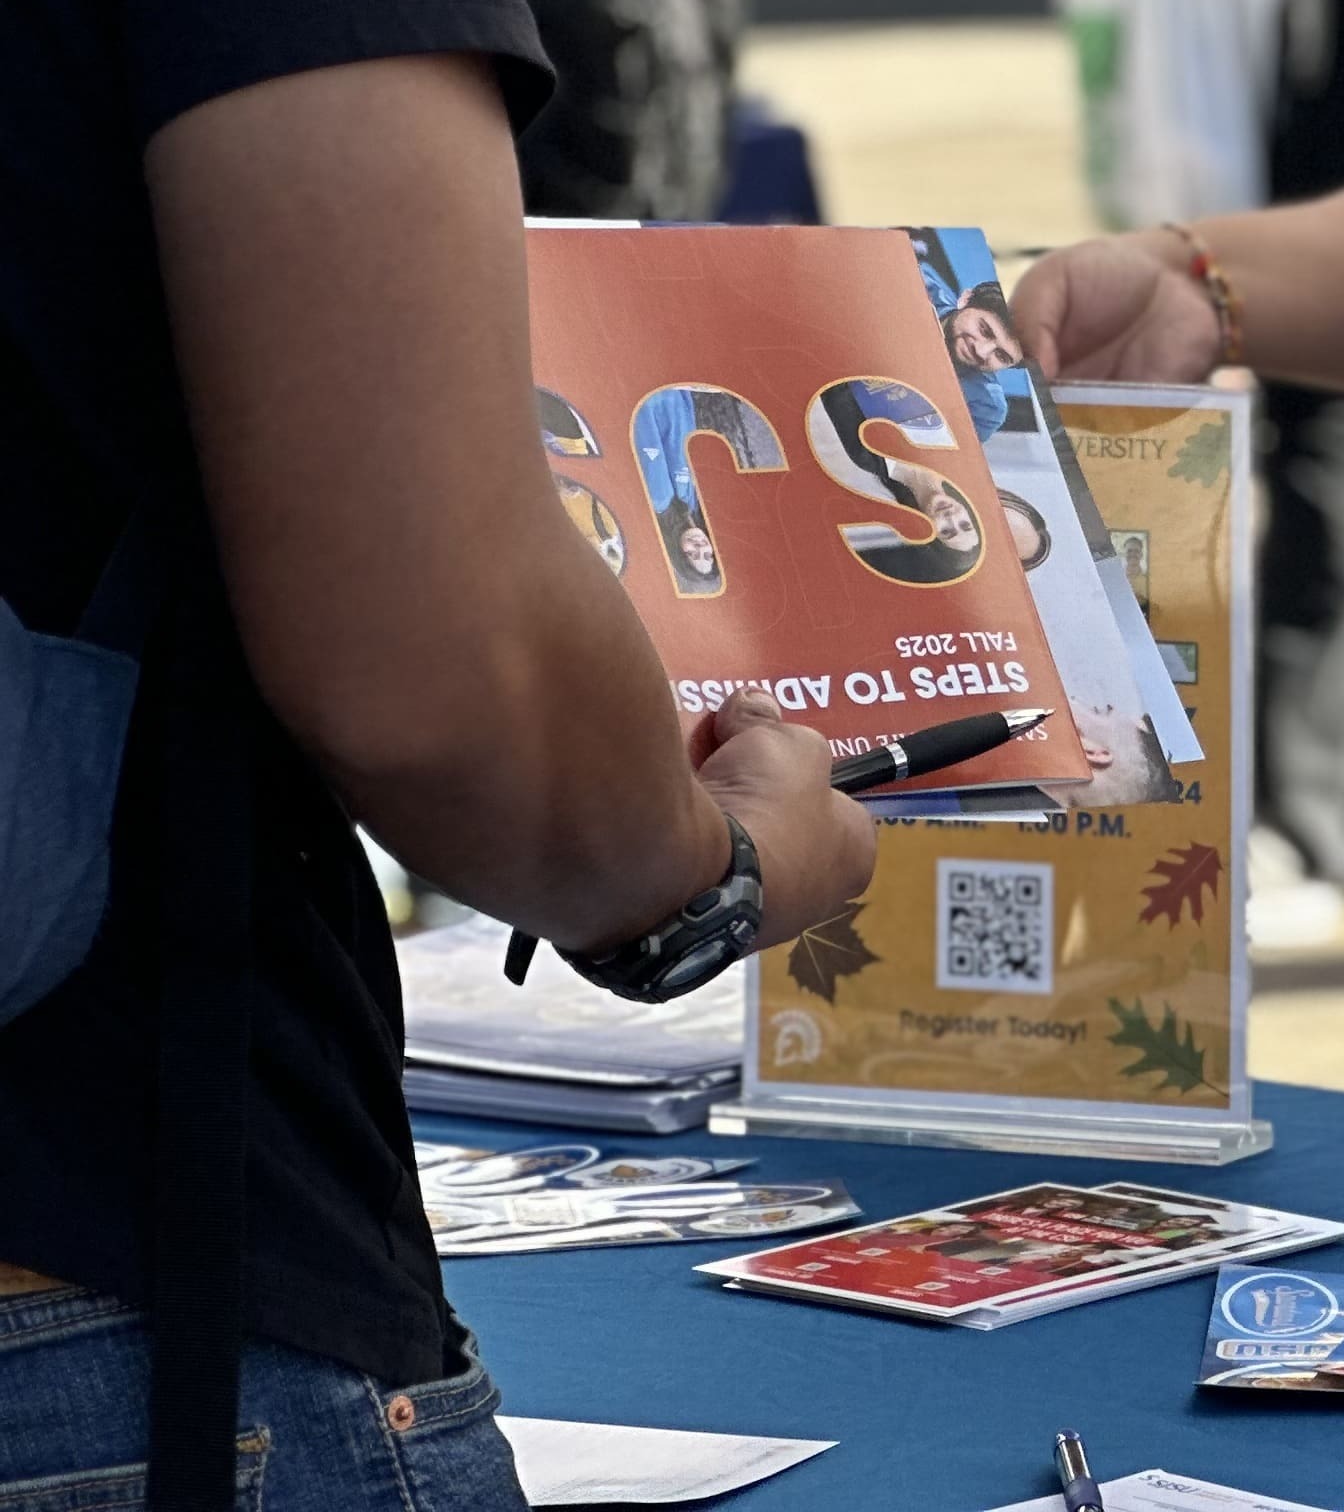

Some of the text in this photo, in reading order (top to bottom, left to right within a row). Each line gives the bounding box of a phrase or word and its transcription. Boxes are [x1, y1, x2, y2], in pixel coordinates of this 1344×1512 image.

[1076, 437, 1166, 461] ERSITY
[895, 631, 1017, 658] FALL 2025
[844, 670, 906, 705] TO
[910, 661, 1030, 699] STEPS
[1077, 814, 1132, 839] P.M.
[900, 1009, 1087, 1045] Register Today!
